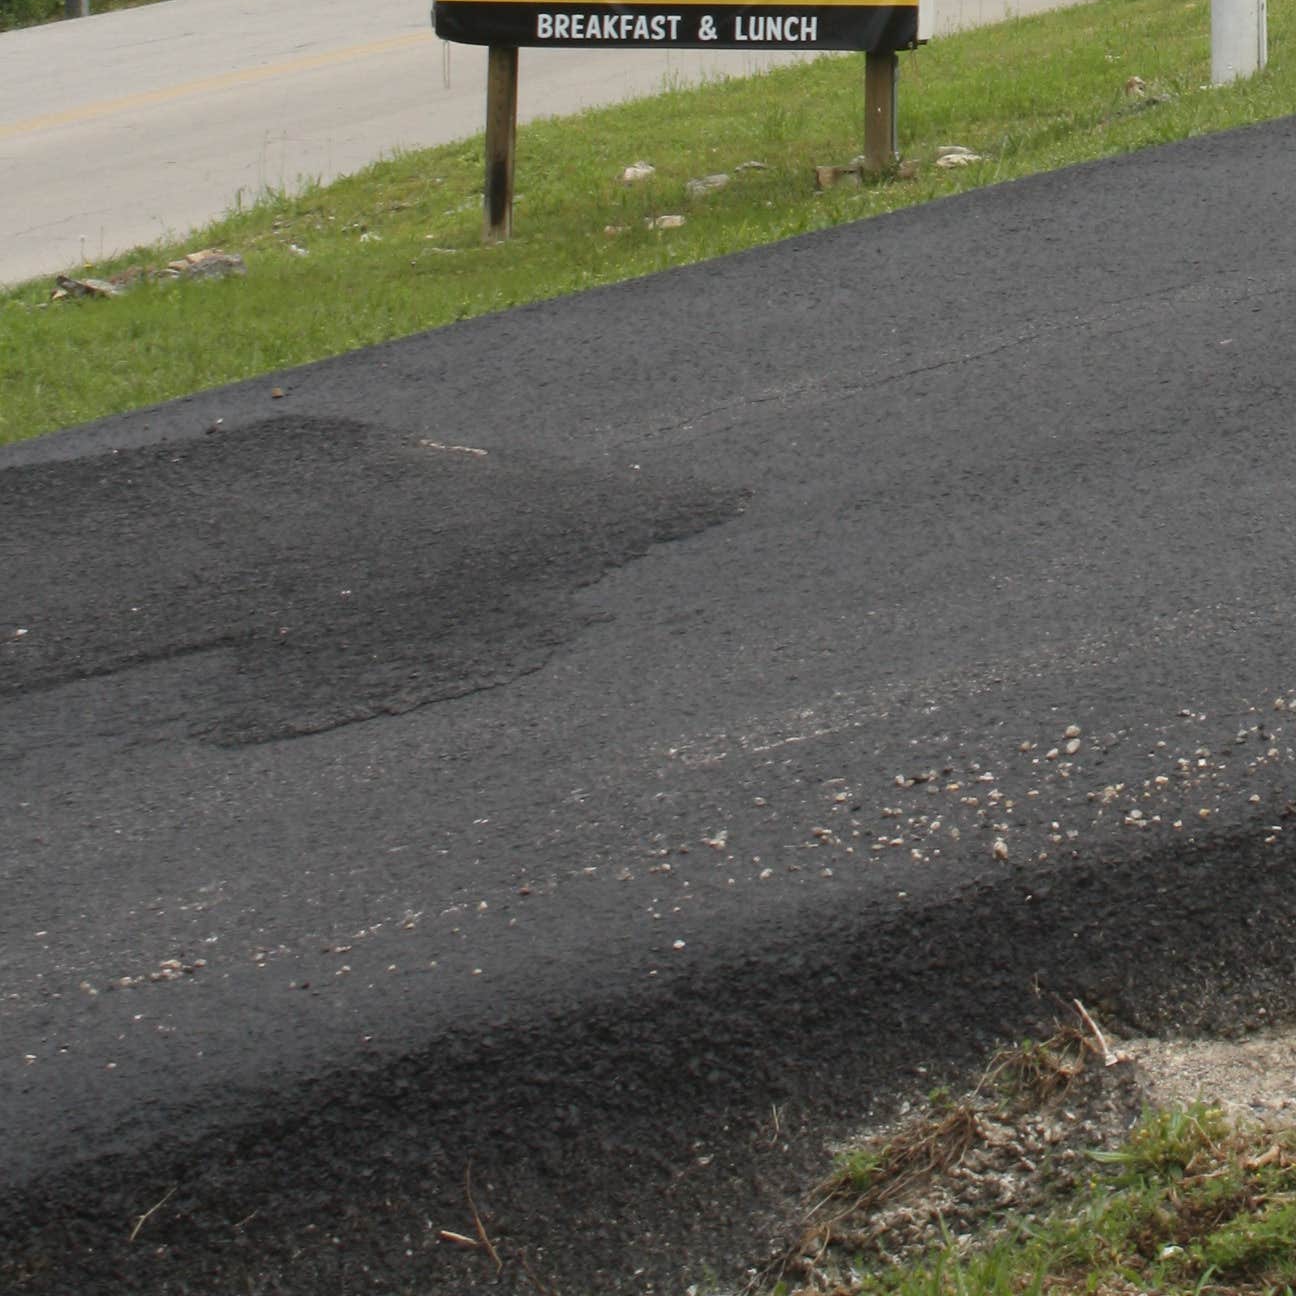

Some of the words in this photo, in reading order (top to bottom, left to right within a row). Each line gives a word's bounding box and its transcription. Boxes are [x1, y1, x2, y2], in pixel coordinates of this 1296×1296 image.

[536, 13, 681, 40] BREAKFAST
[698, 14, 718, 41] &
[735, 16, 818, 41] LUNCH
